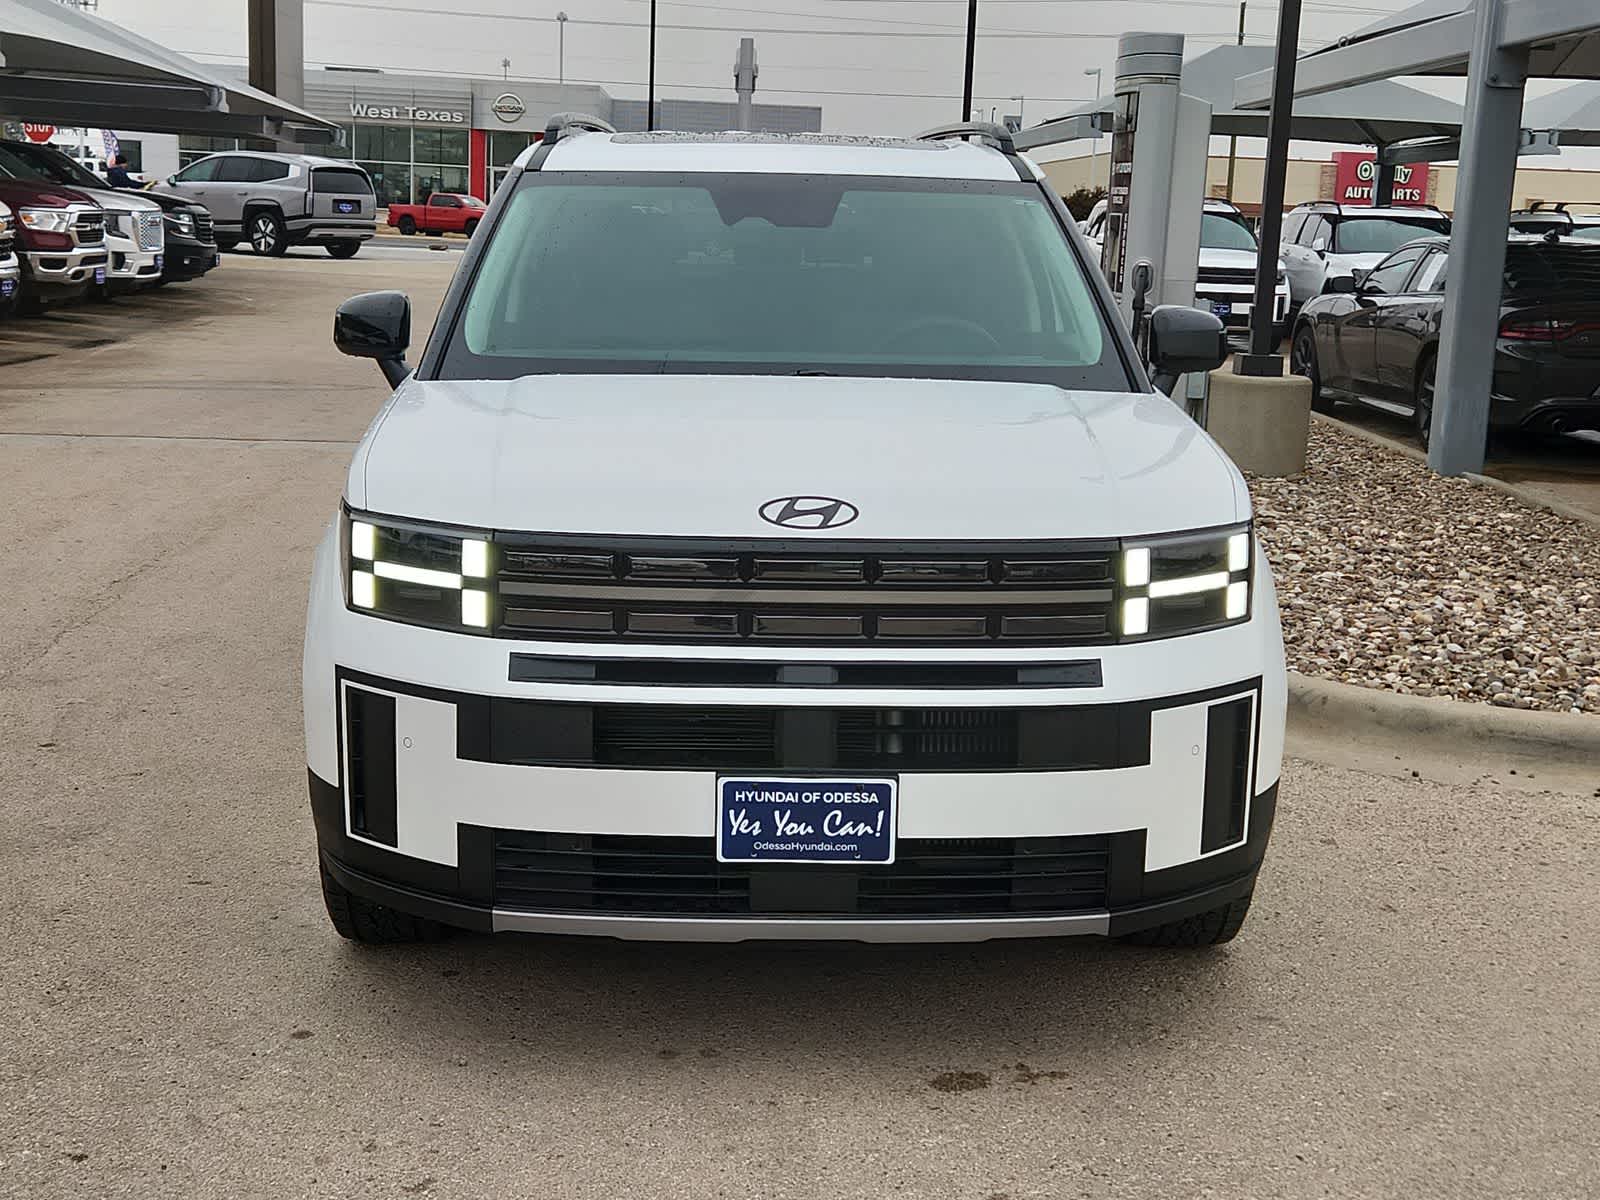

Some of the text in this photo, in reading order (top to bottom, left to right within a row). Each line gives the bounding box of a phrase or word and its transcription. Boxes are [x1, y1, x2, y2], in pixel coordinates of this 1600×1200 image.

[349, 103, 464, 123] West Texas
[735, 791, 879, 804] HYUNDAI OF ODESSA
[729, 808, 885, 837] Yes You Can!
[753, 841, 858, 852] OdessaHyundai.com
